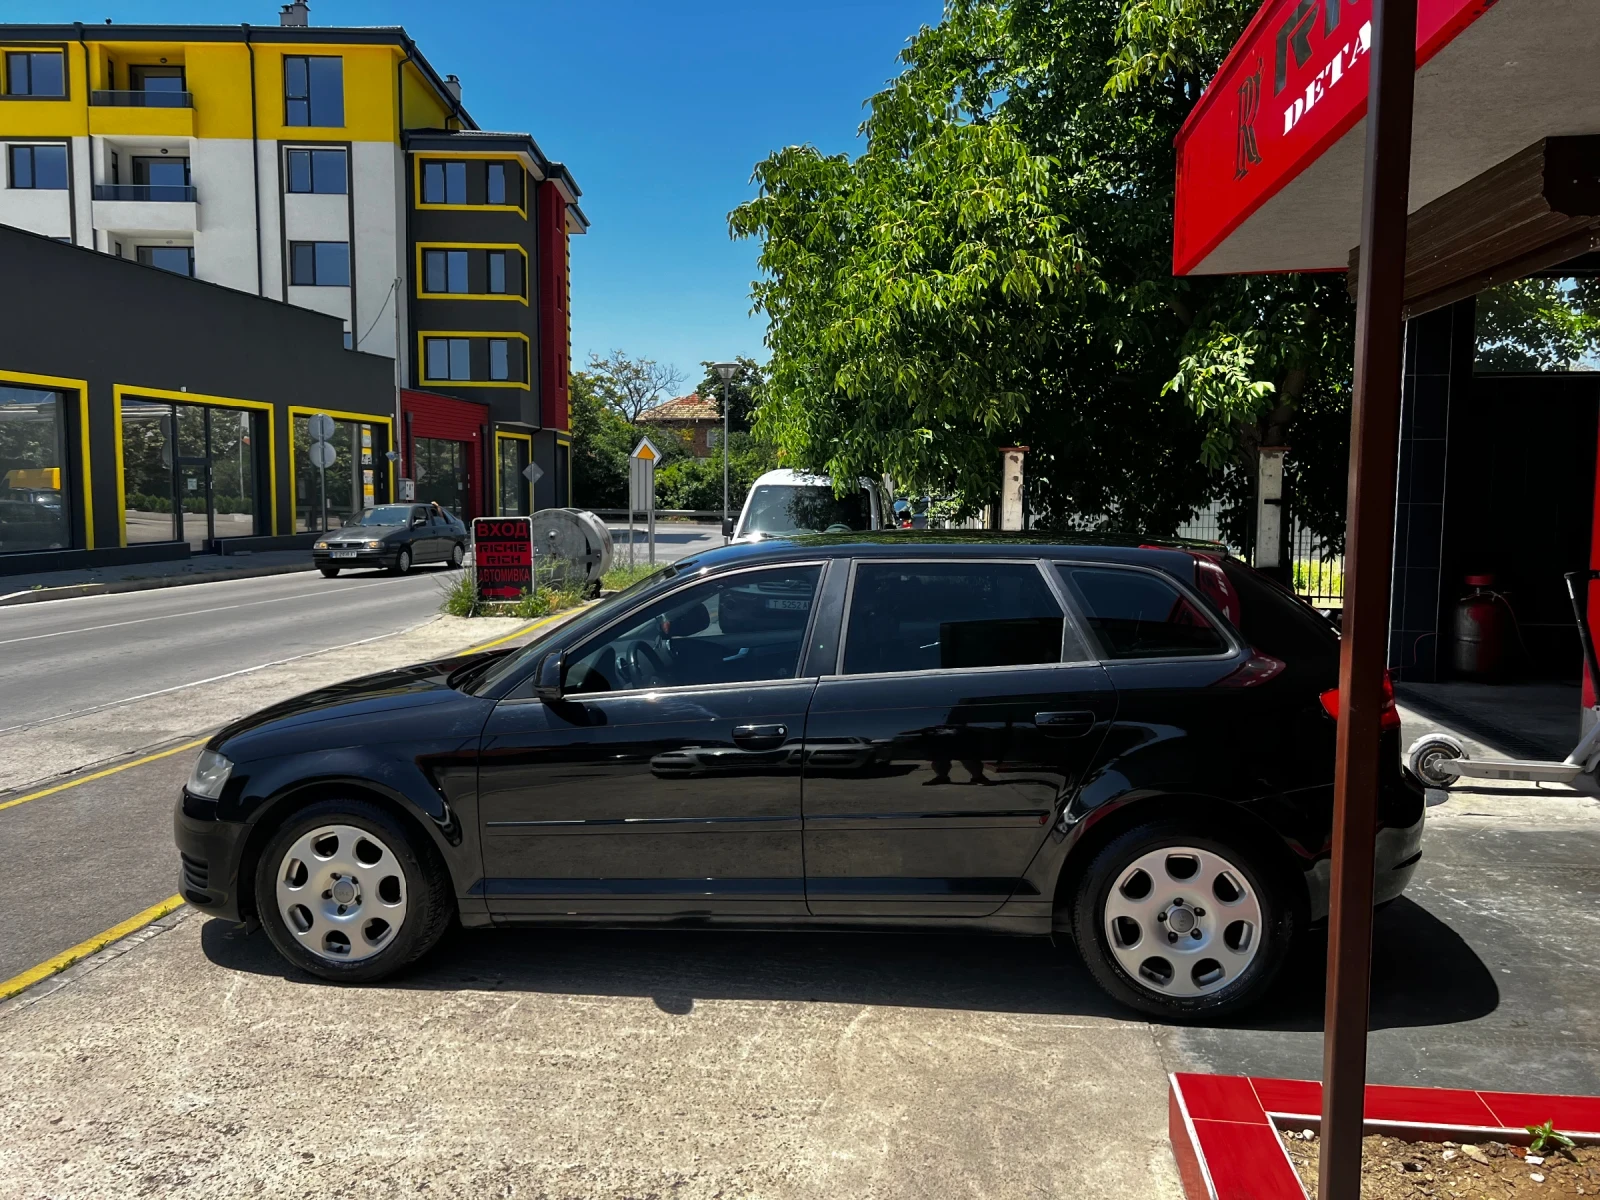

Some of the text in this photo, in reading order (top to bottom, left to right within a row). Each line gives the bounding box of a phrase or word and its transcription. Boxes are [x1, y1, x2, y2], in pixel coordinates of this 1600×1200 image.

[477, 522, 528, 538] ВХОД
[480, 544, 527, 552] RICHIE
[487, 556, 520, 564] RICH
[479, 568, 530, 581] АВТОМИВКА
